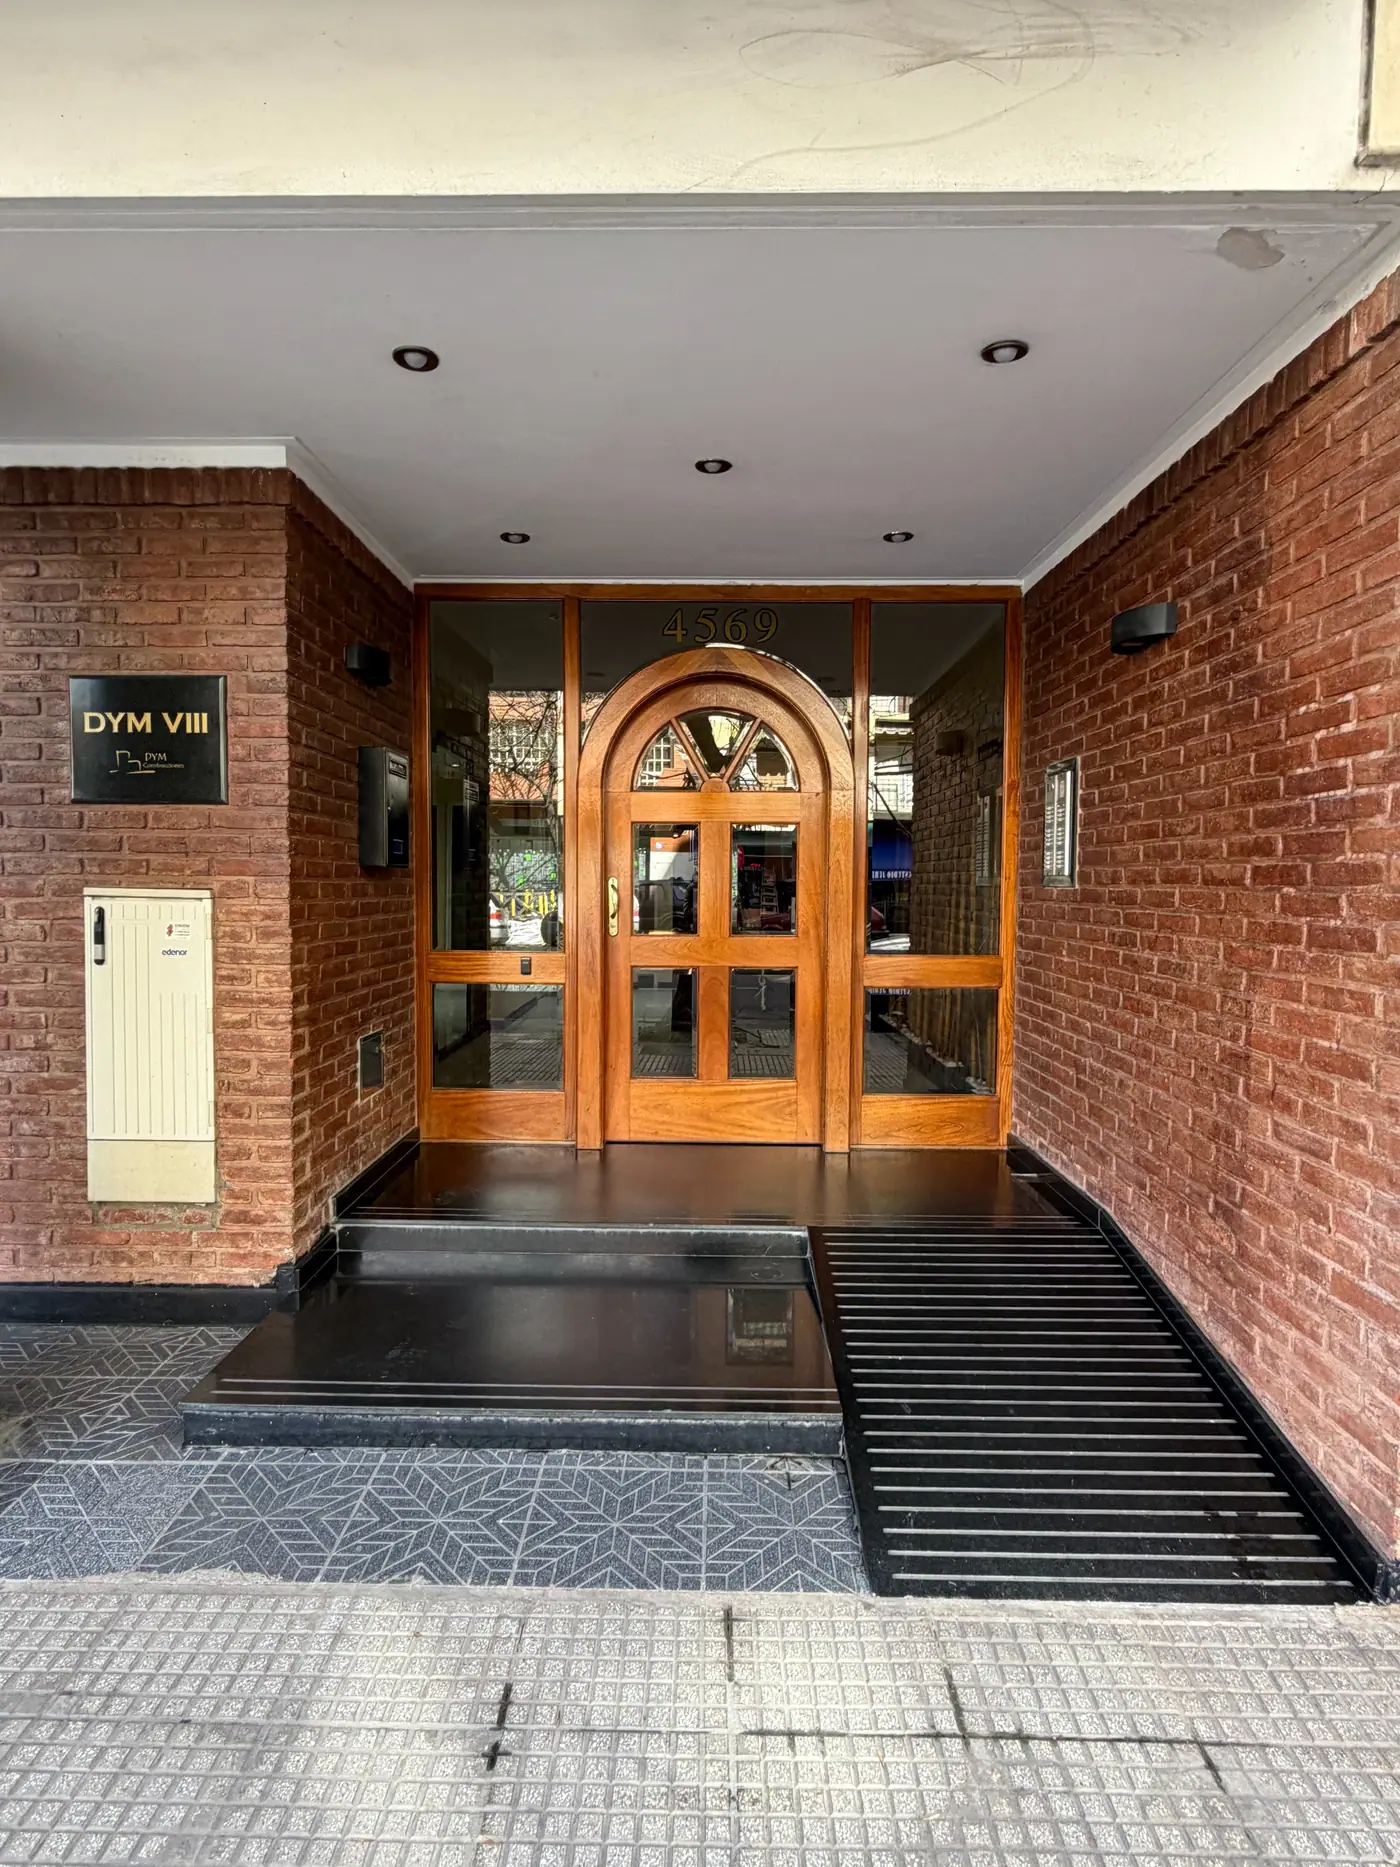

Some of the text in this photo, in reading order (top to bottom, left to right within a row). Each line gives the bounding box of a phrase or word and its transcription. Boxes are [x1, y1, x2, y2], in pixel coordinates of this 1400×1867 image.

[662, 607, 778, 643] 4569
[83, 712, 208, 733] DYM VIII
[145, 752, 167, 761] DYM
[162, 948, 187, 956] edenor
